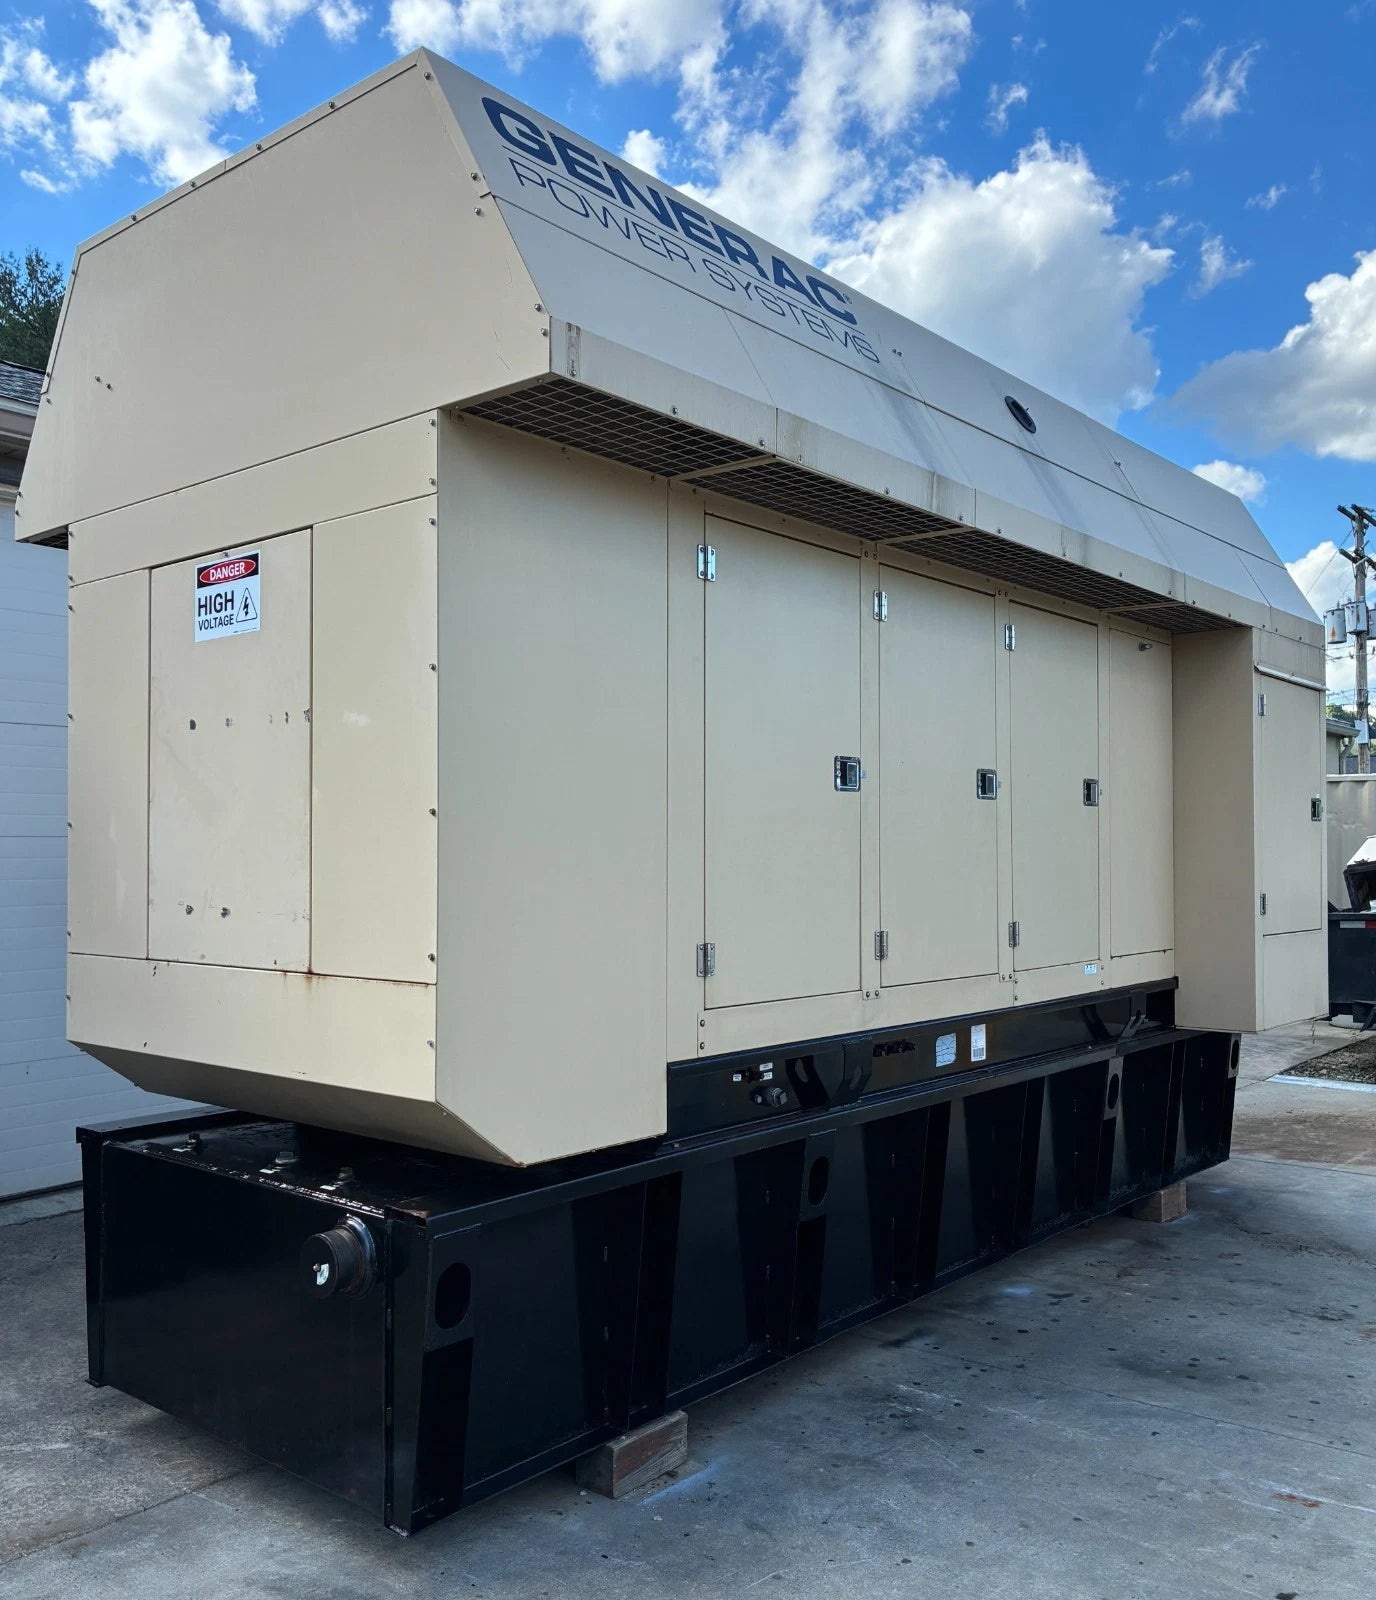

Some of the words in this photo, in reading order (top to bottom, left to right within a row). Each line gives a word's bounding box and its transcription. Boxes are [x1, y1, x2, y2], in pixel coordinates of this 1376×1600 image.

[482, 97, 857, 326] GENERAC
[508, 157, 697, 273] POWER
[701, 258, 881, 364] SYSTEMS
[209, 562, 245, 581] DANGER
[198, 590, 235, 617] HIGH
[198, 614, 235, 631] VOLTAGE
